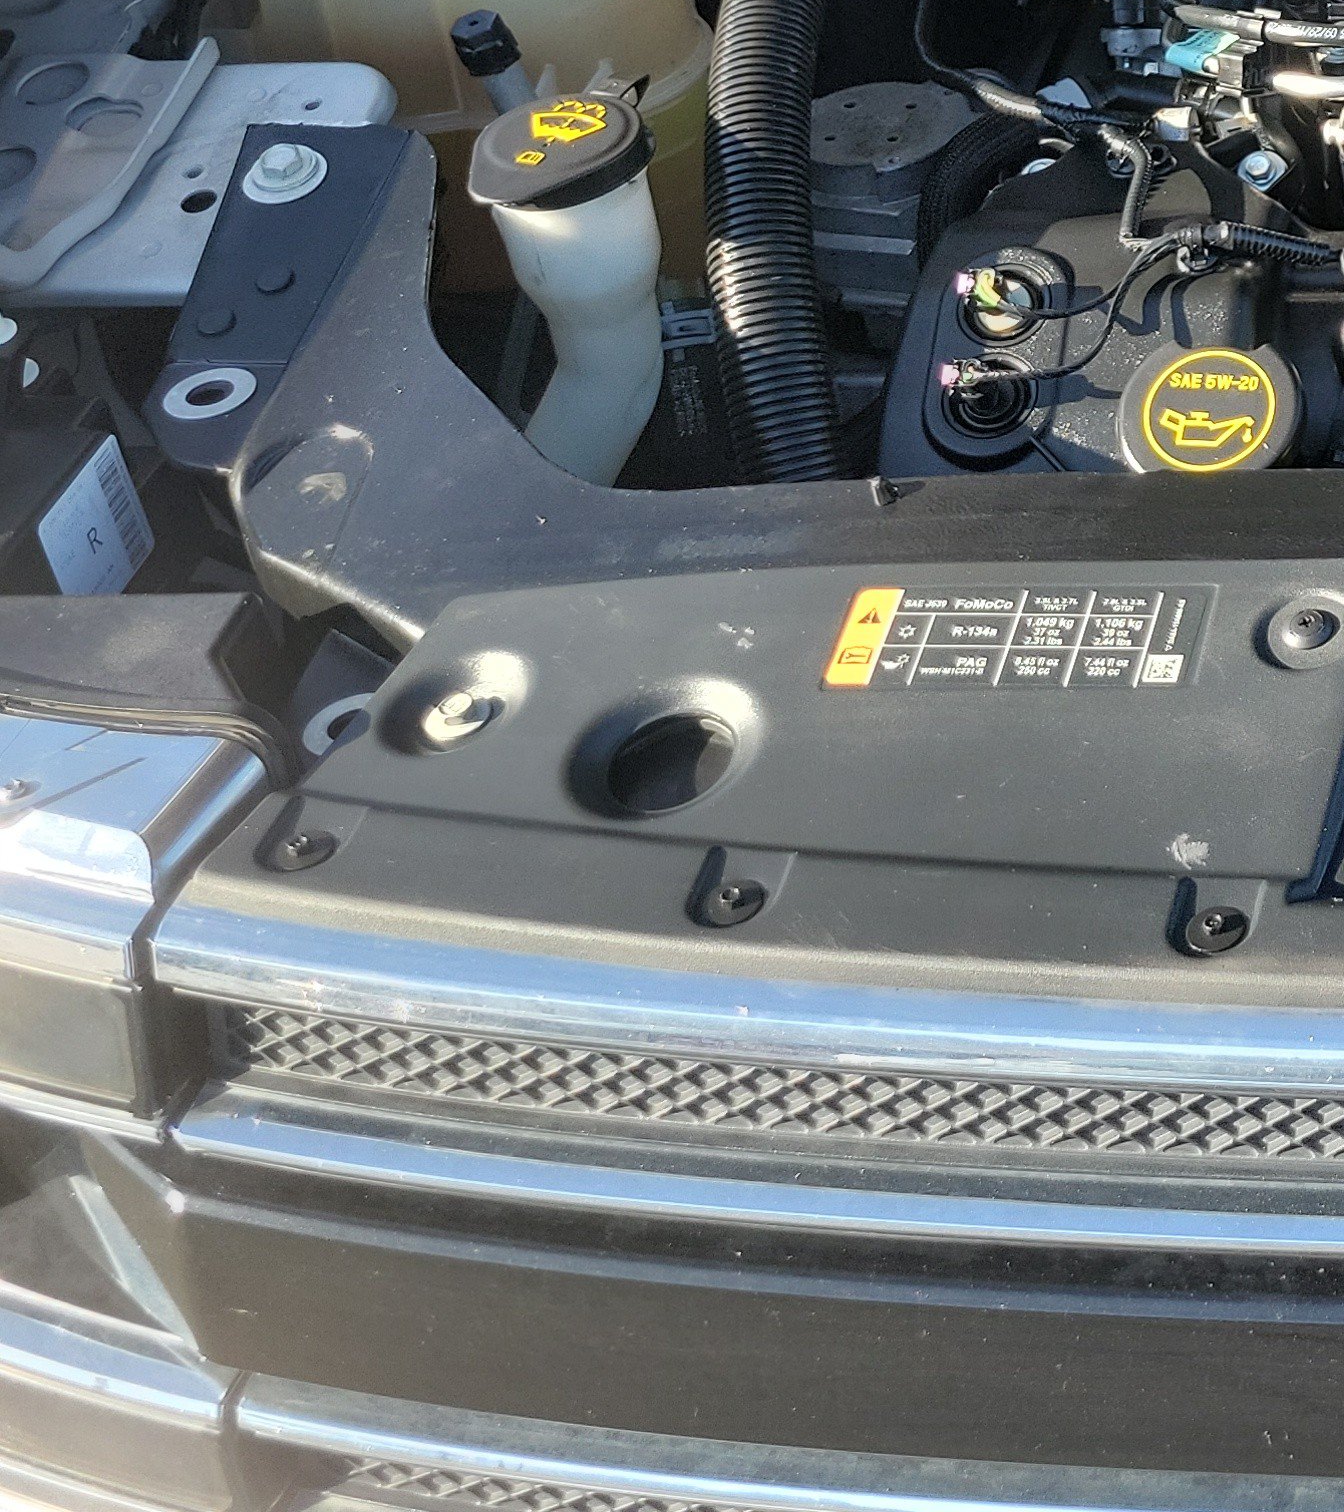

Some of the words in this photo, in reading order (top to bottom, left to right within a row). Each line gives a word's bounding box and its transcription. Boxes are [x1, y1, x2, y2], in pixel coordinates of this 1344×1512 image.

[1169, 372, 1203, 390] SAE
[1204, 374, 1261, 391] 5W-20
[86, 526, 104, 555] R
[904, 599, 925, 609] SAE
[954, 597, 1015, 610] FoMoCo
[1058, 618, 1075, 630] kg
[1127, 618, 1144, 631] kg
[951, 626, 999, 638] R-134a
[1032, 627, 1047, 637] 37
[1047, 628, 1061, 637] oz
[1116, 629, 1130, 638] oz
[1046, 637, 1063, 646] lbs
[1115, 637, 1132, 647] lbs
[956, 656, 988, 668] PAG
[1046, 658, 1060, 668] oz
[1116, 658, 1130, 668] oz
[1037, 667, 1051, 676] cc
[1107, 667, 1121, 677] cc
